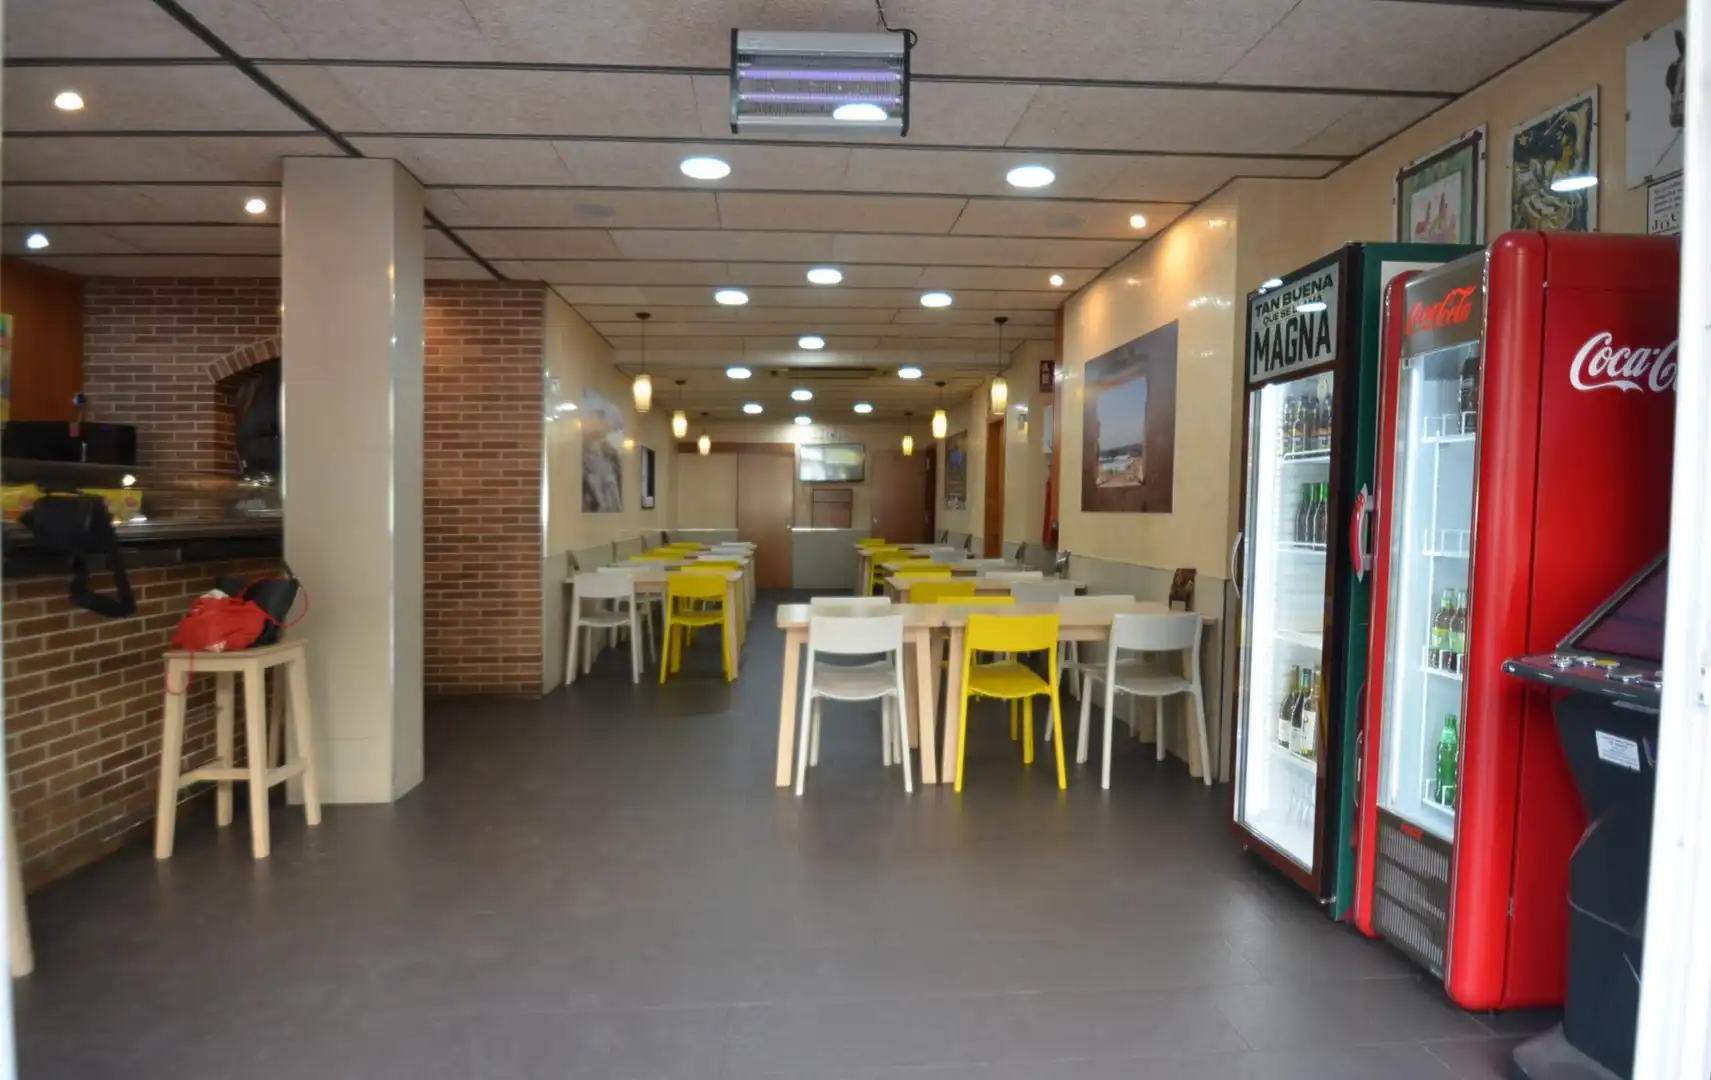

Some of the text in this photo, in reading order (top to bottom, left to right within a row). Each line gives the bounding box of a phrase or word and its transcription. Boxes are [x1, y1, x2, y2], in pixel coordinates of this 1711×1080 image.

[1255, 273, 1333, 317] TAN BUENA
[1281, 307, 1290, 318] SE
[1292, 293, 1324, 313] LMA
[1253, 309, 1331, 375] MAGNA
[1569, 331, 1679, 393] Coca-C
